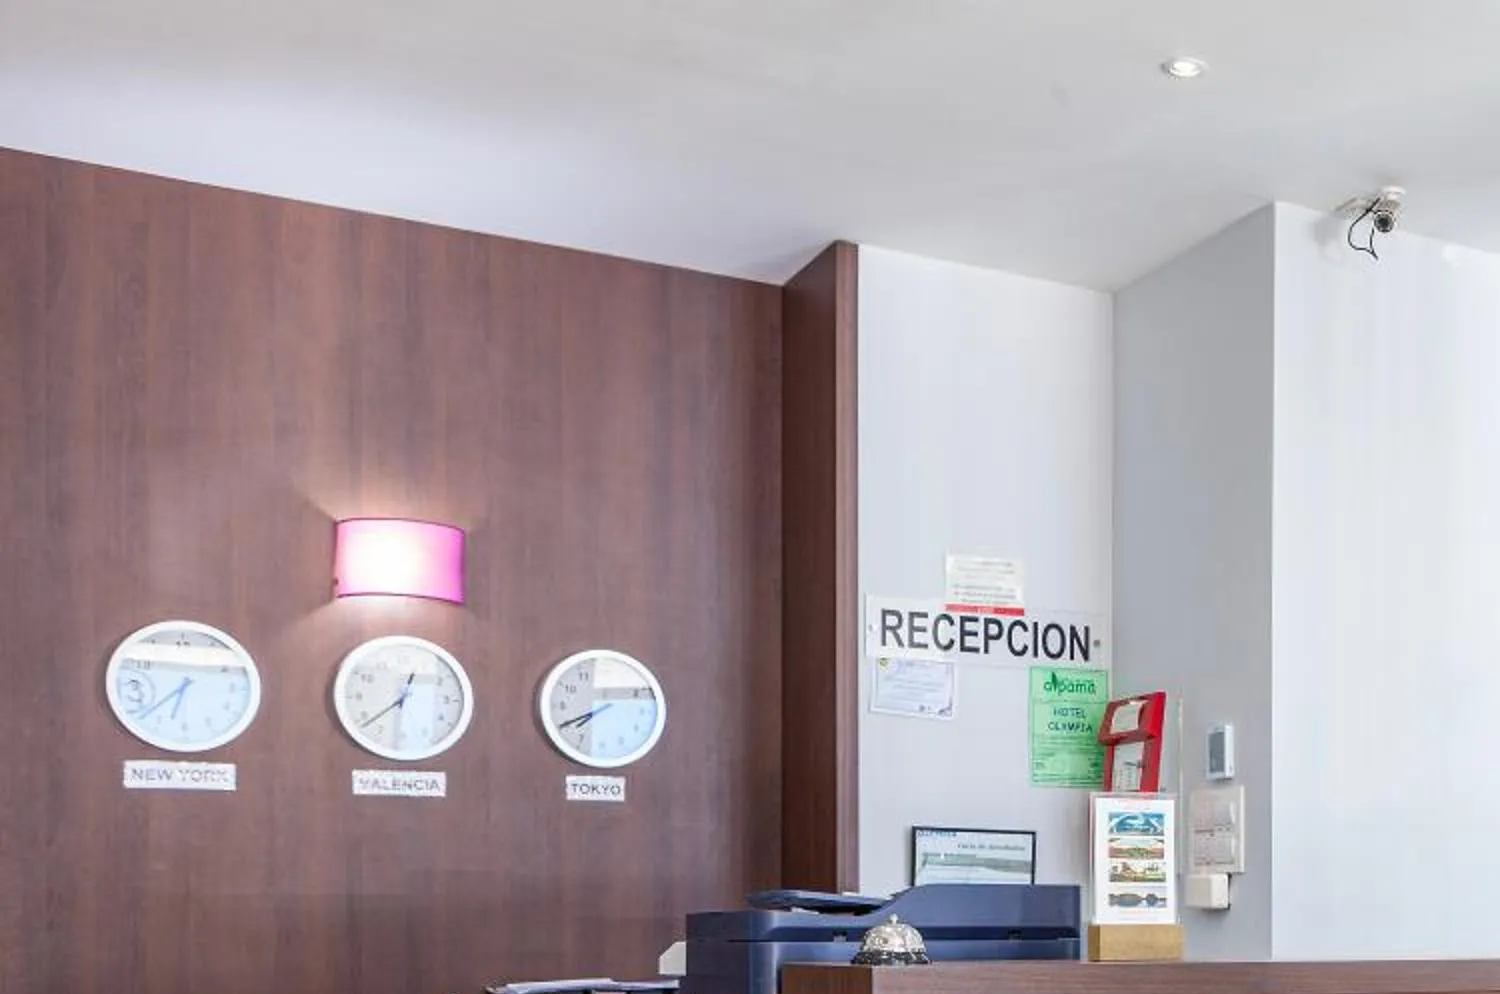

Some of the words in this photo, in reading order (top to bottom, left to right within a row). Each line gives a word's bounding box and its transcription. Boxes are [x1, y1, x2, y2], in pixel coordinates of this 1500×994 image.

[880, 608, 1090, 662] RECEPCION
[1053, 707, 1087, 719] HOTEL
[1048, 721, 1093, 733] OLYMPIA
[131, 767, 173, 782] NEW
[178, 769, 230, 784] YORK
[359, 777, 441, 792] VALENCIA
[571, 783, 622, 796] TOKYO
